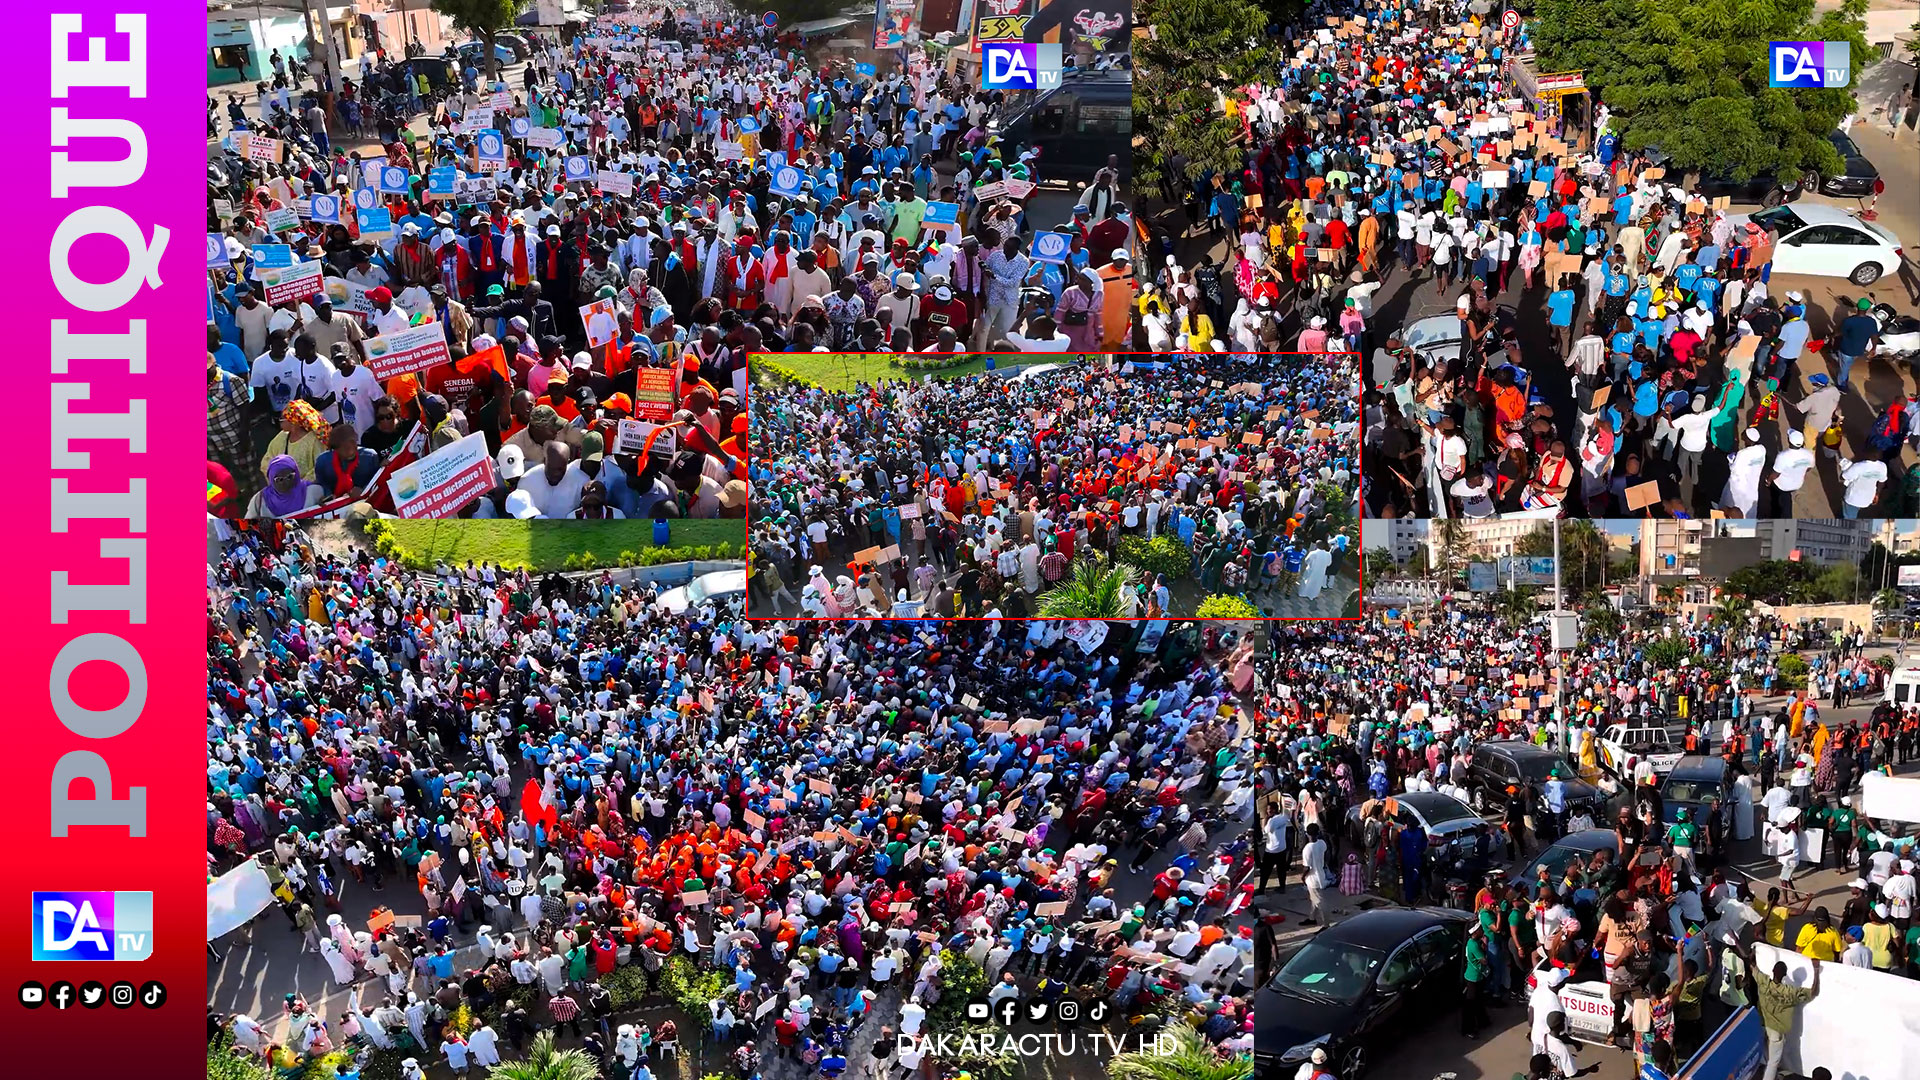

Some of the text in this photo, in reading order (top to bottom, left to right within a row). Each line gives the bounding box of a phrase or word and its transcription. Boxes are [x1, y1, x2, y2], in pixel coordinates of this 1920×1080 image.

[483, 138, 498, 150] NR
[570, 160, 584, 169] NR
[387, 172, 403, 184] NR
[781, 171, 796, 185] NR
[359, 193, 372, 204] NR
[318, 199, 332, 211] NR
[1043, 239, 1061, 250] NR
[1682, 268, 1697, 277] NR
[1702, 280, 1716, 290] NR
[1621, 333, 1635, 346] NR
[372, 360, 381, 369] Le
[382, 357, 396, 367] PSD
[396, 353, 413, 365] pour
[421, 344, 444, 356] baisse
[376, 354, 447, 379] des prix des denrées
[402, 500, 426, 519] Non
[425, 496, 433, 507] à
[432, 490, 443, 503] la
[442, 471, 479, 498] dictature
[440, 480, 489, 514] démocratie.
[1651, 760, 1674, 768] OLICE
